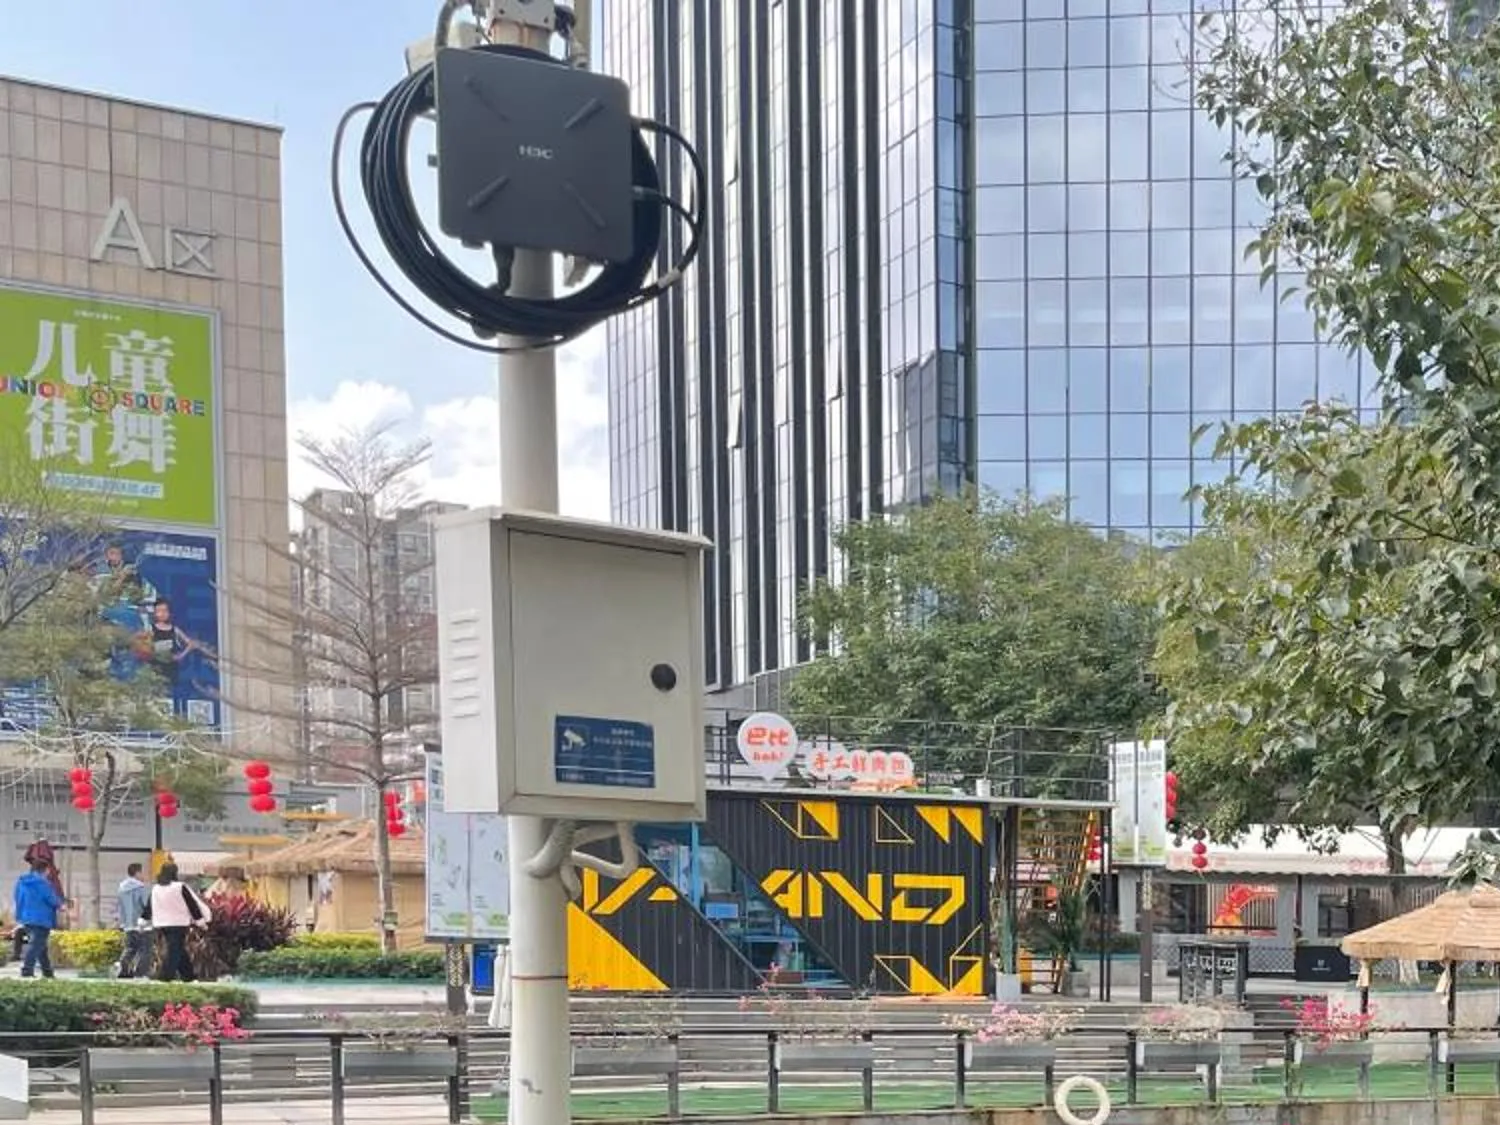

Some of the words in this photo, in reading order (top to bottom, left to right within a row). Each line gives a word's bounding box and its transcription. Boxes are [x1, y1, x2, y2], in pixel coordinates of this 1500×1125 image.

[92, 197, 223, 281] A区
[25, 319, 175, 393] 儿童
[25, 398, 177, 473] 街舞
[121, 391, 205, 416] SQUARE
